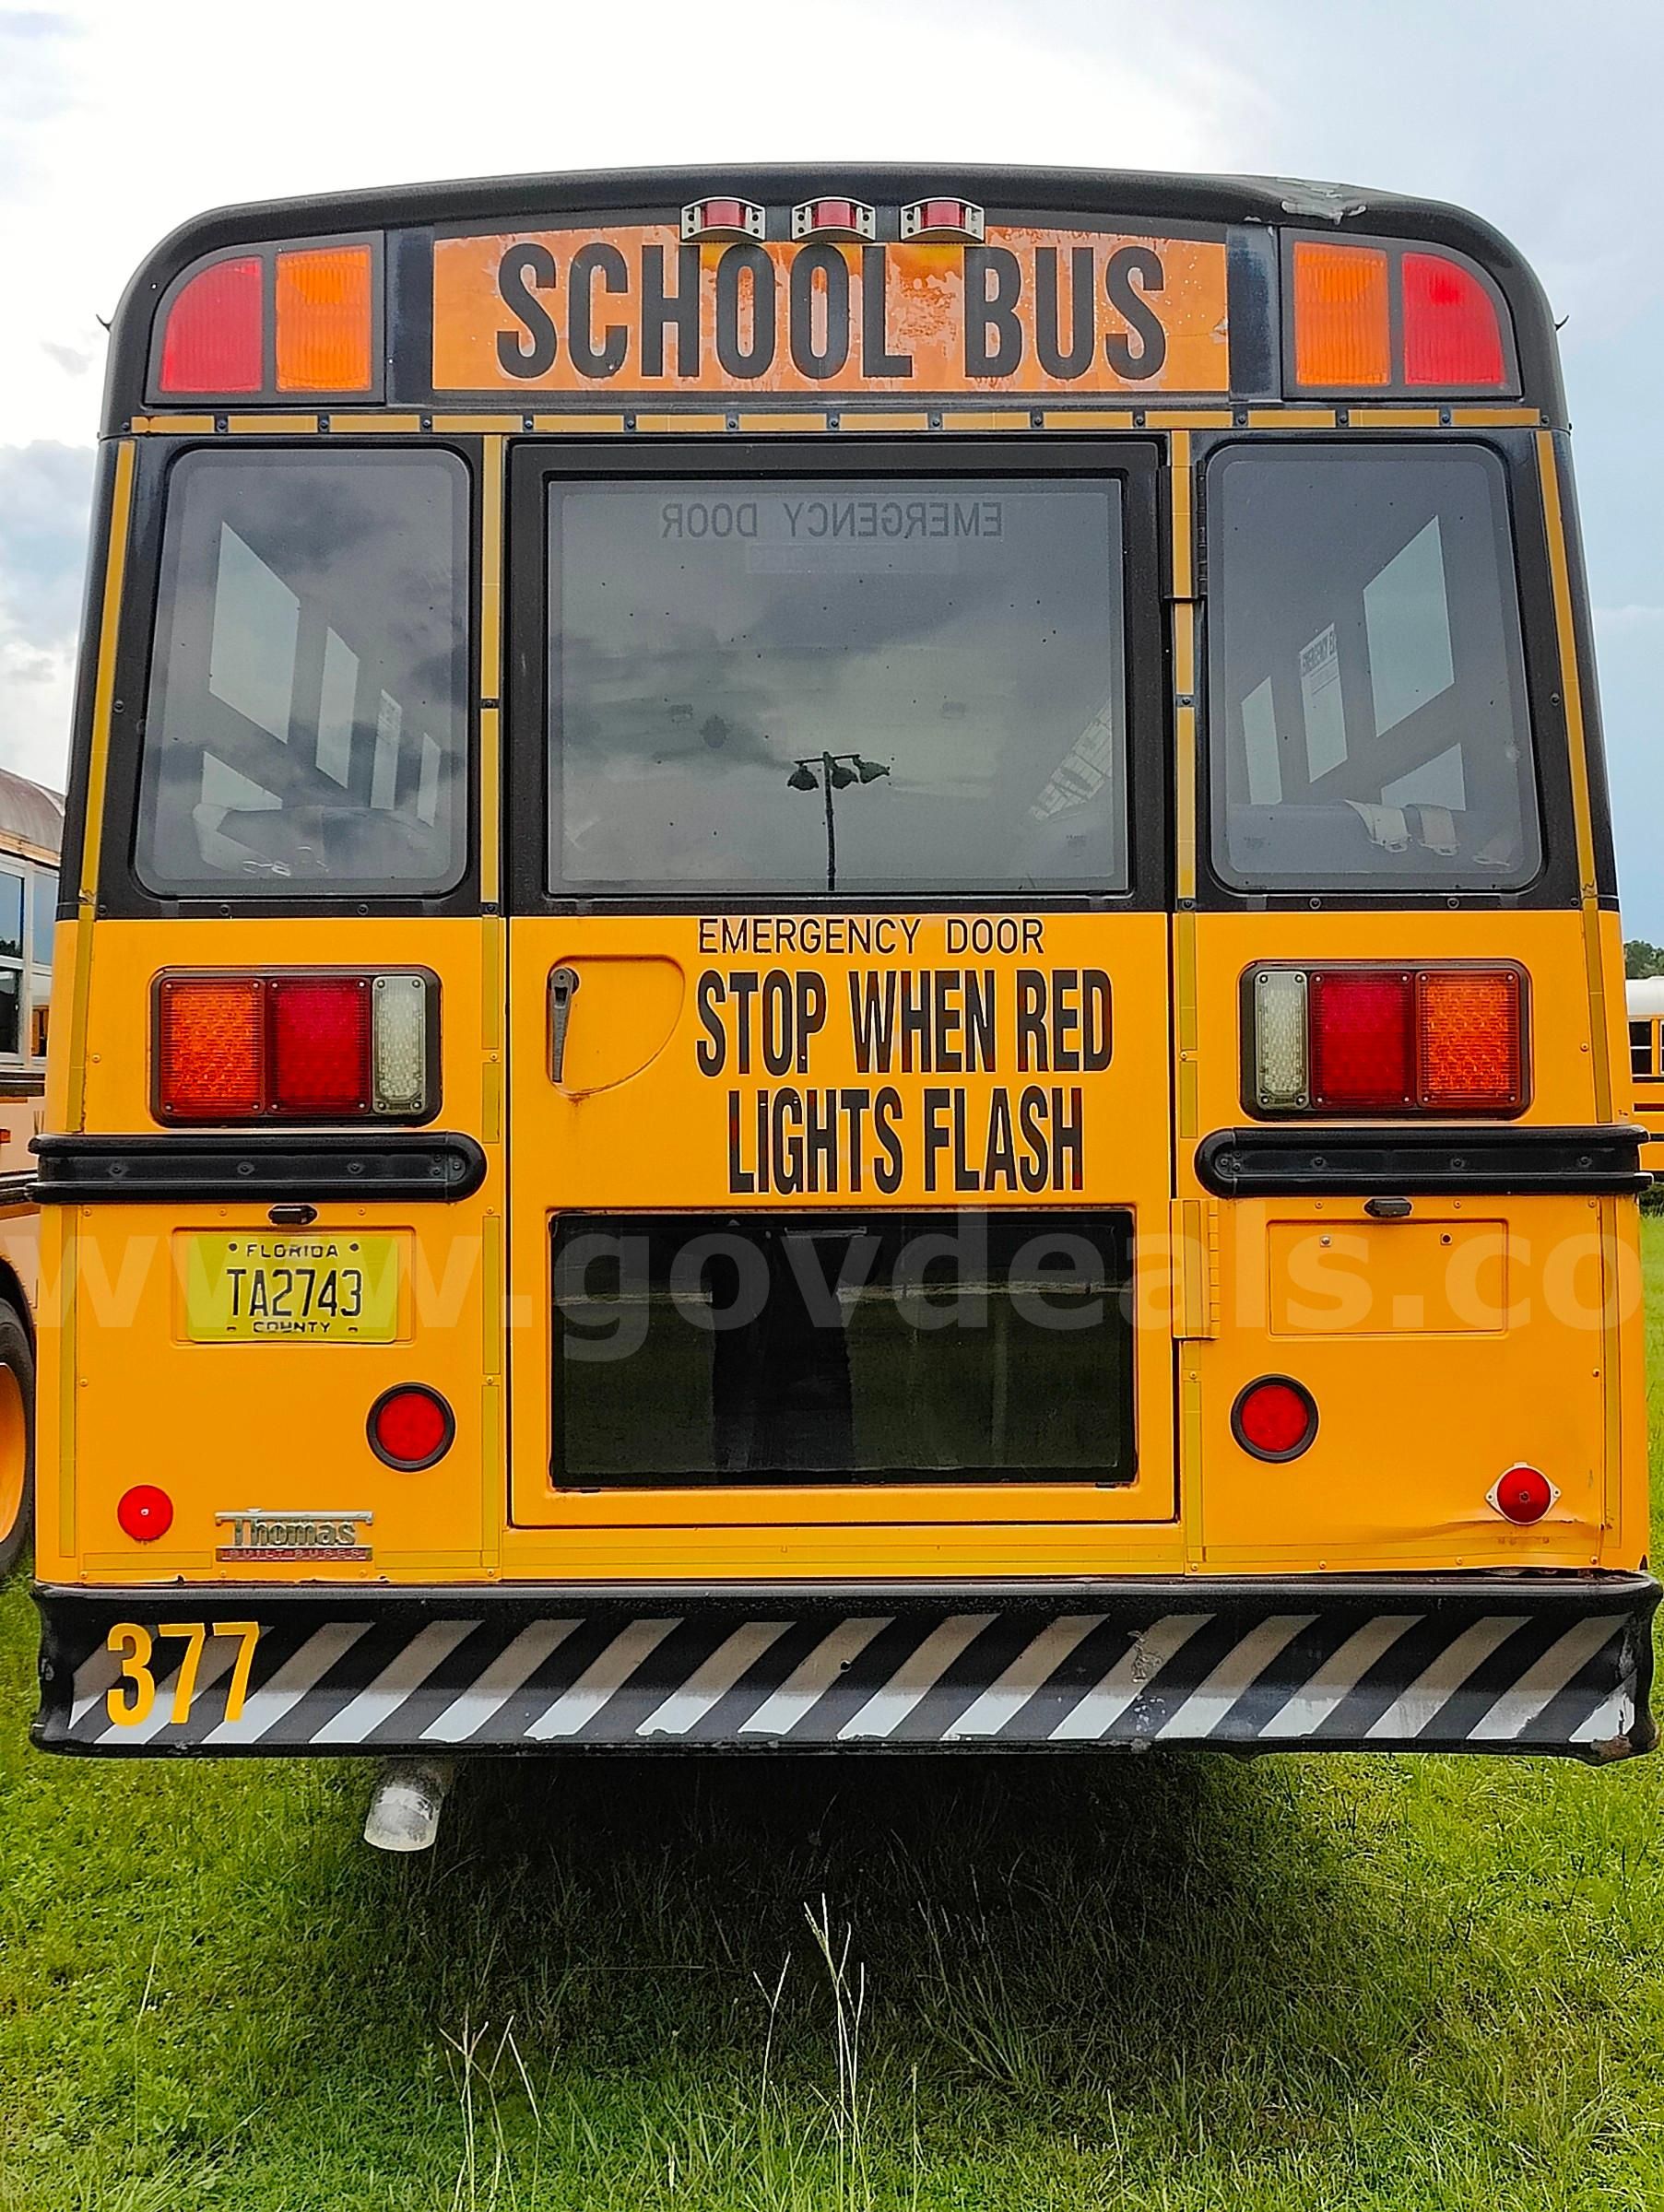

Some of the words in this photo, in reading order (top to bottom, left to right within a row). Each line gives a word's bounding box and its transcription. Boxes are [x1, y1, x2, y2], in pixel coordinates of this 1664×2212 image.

[497, 242, 913, 382] SCHOOL
[964, 244, 1166, 381] BUS
[699, 918, 922, 954] EMERGENCY
[947, 918, 1044, 954] DOOR
[696, 970, 826, 1077] STOP
[848, 970, 997, 1074] WHEN
[1017, 969, 1113, 1073] RED
[727, 1086, 903, 1194] LIGHTS
[923, 1085, 1082, 1192] FLASH
[246, 1243, 338, 1258] FLORIDA
[227, 1268, 362, 1317] TA2743
[253, 1321, 331, 1333] COUNTY
[226, 1511, 361, 1547] Thomas
[230, 1549, 285, 1559] BUILT
[294, 1549, 361, 1559] BUSES
[106, 1621, 260, 1726] 377
